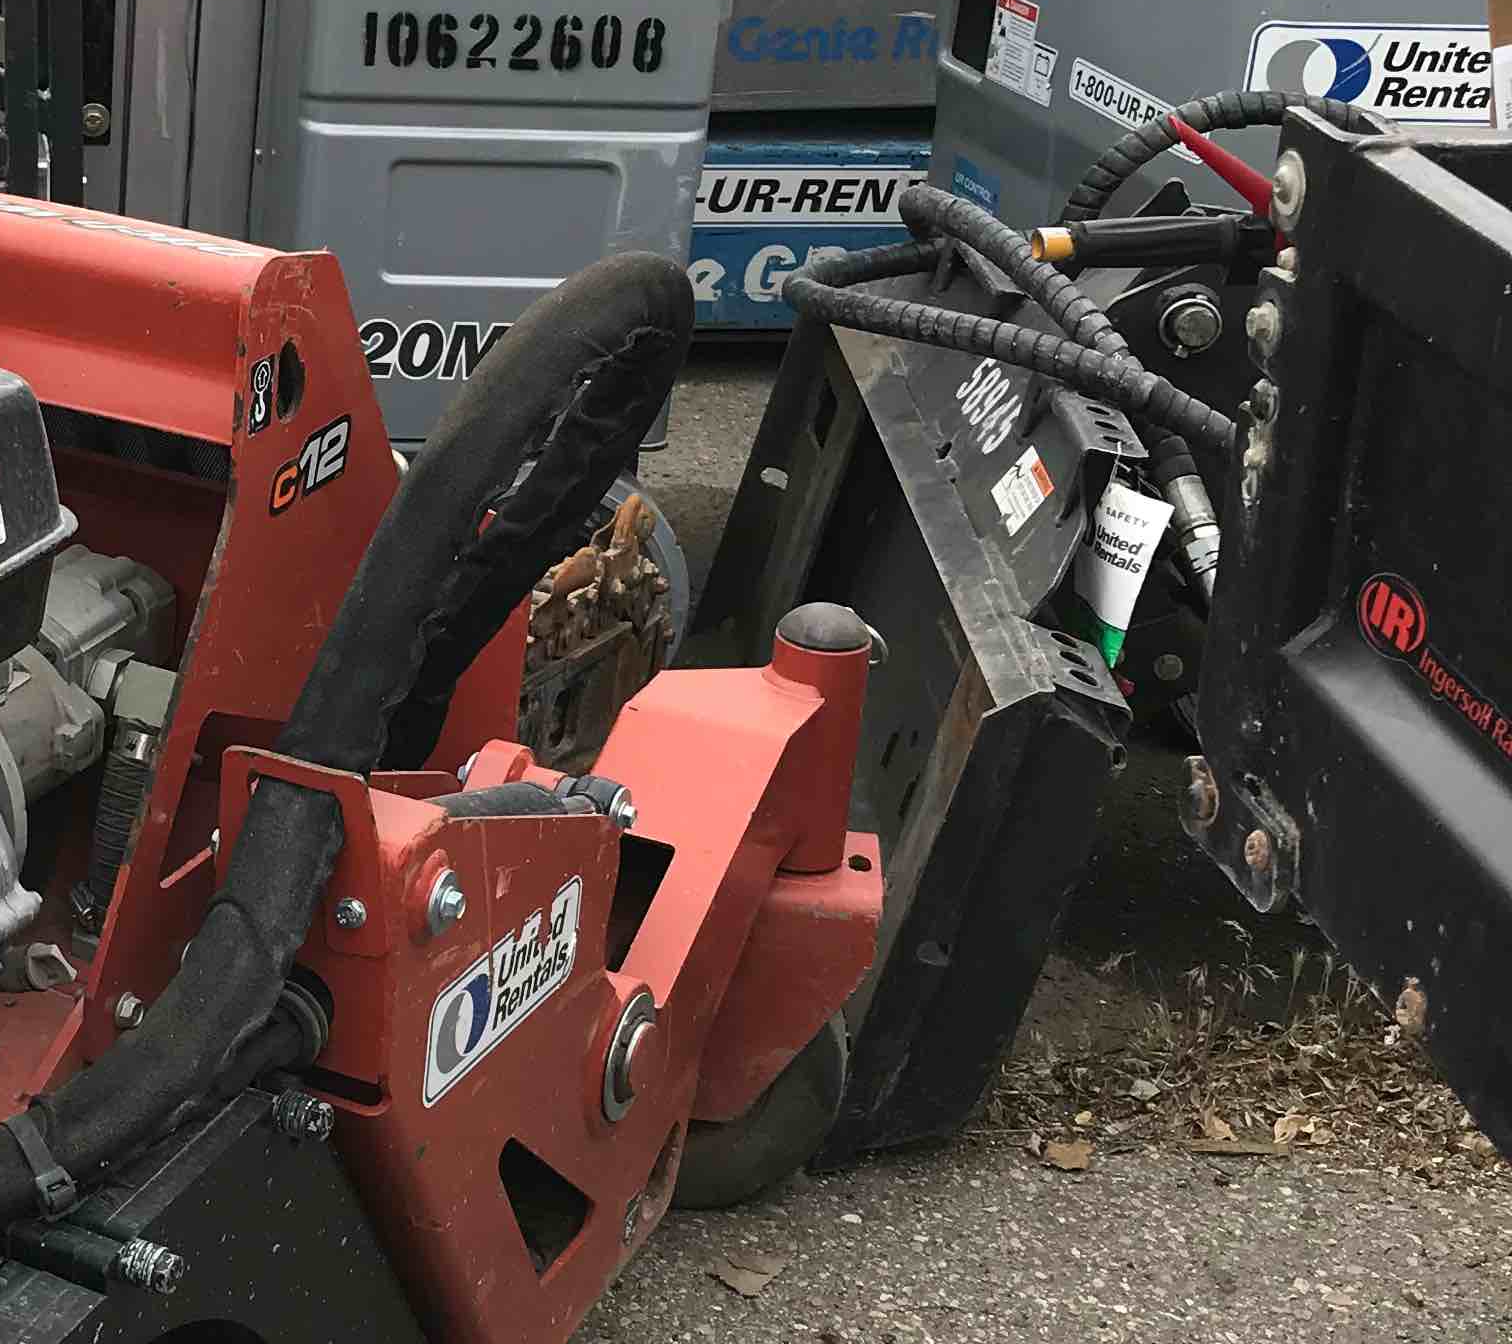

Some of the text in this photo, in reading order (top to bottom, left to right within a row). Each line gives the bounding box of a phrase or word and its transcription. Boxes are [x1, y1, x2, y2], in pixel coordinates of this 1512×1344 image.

[363, 12, 667, 73] 10622608
[695, 176, 929, 214] -UR-REN
[1094, 540, 1142, 574] Rentals
[1096, 523, 1145, 556] United
[497, 899, 570, 988] Unitd
[491, 940, 570, 1032] Rentals
